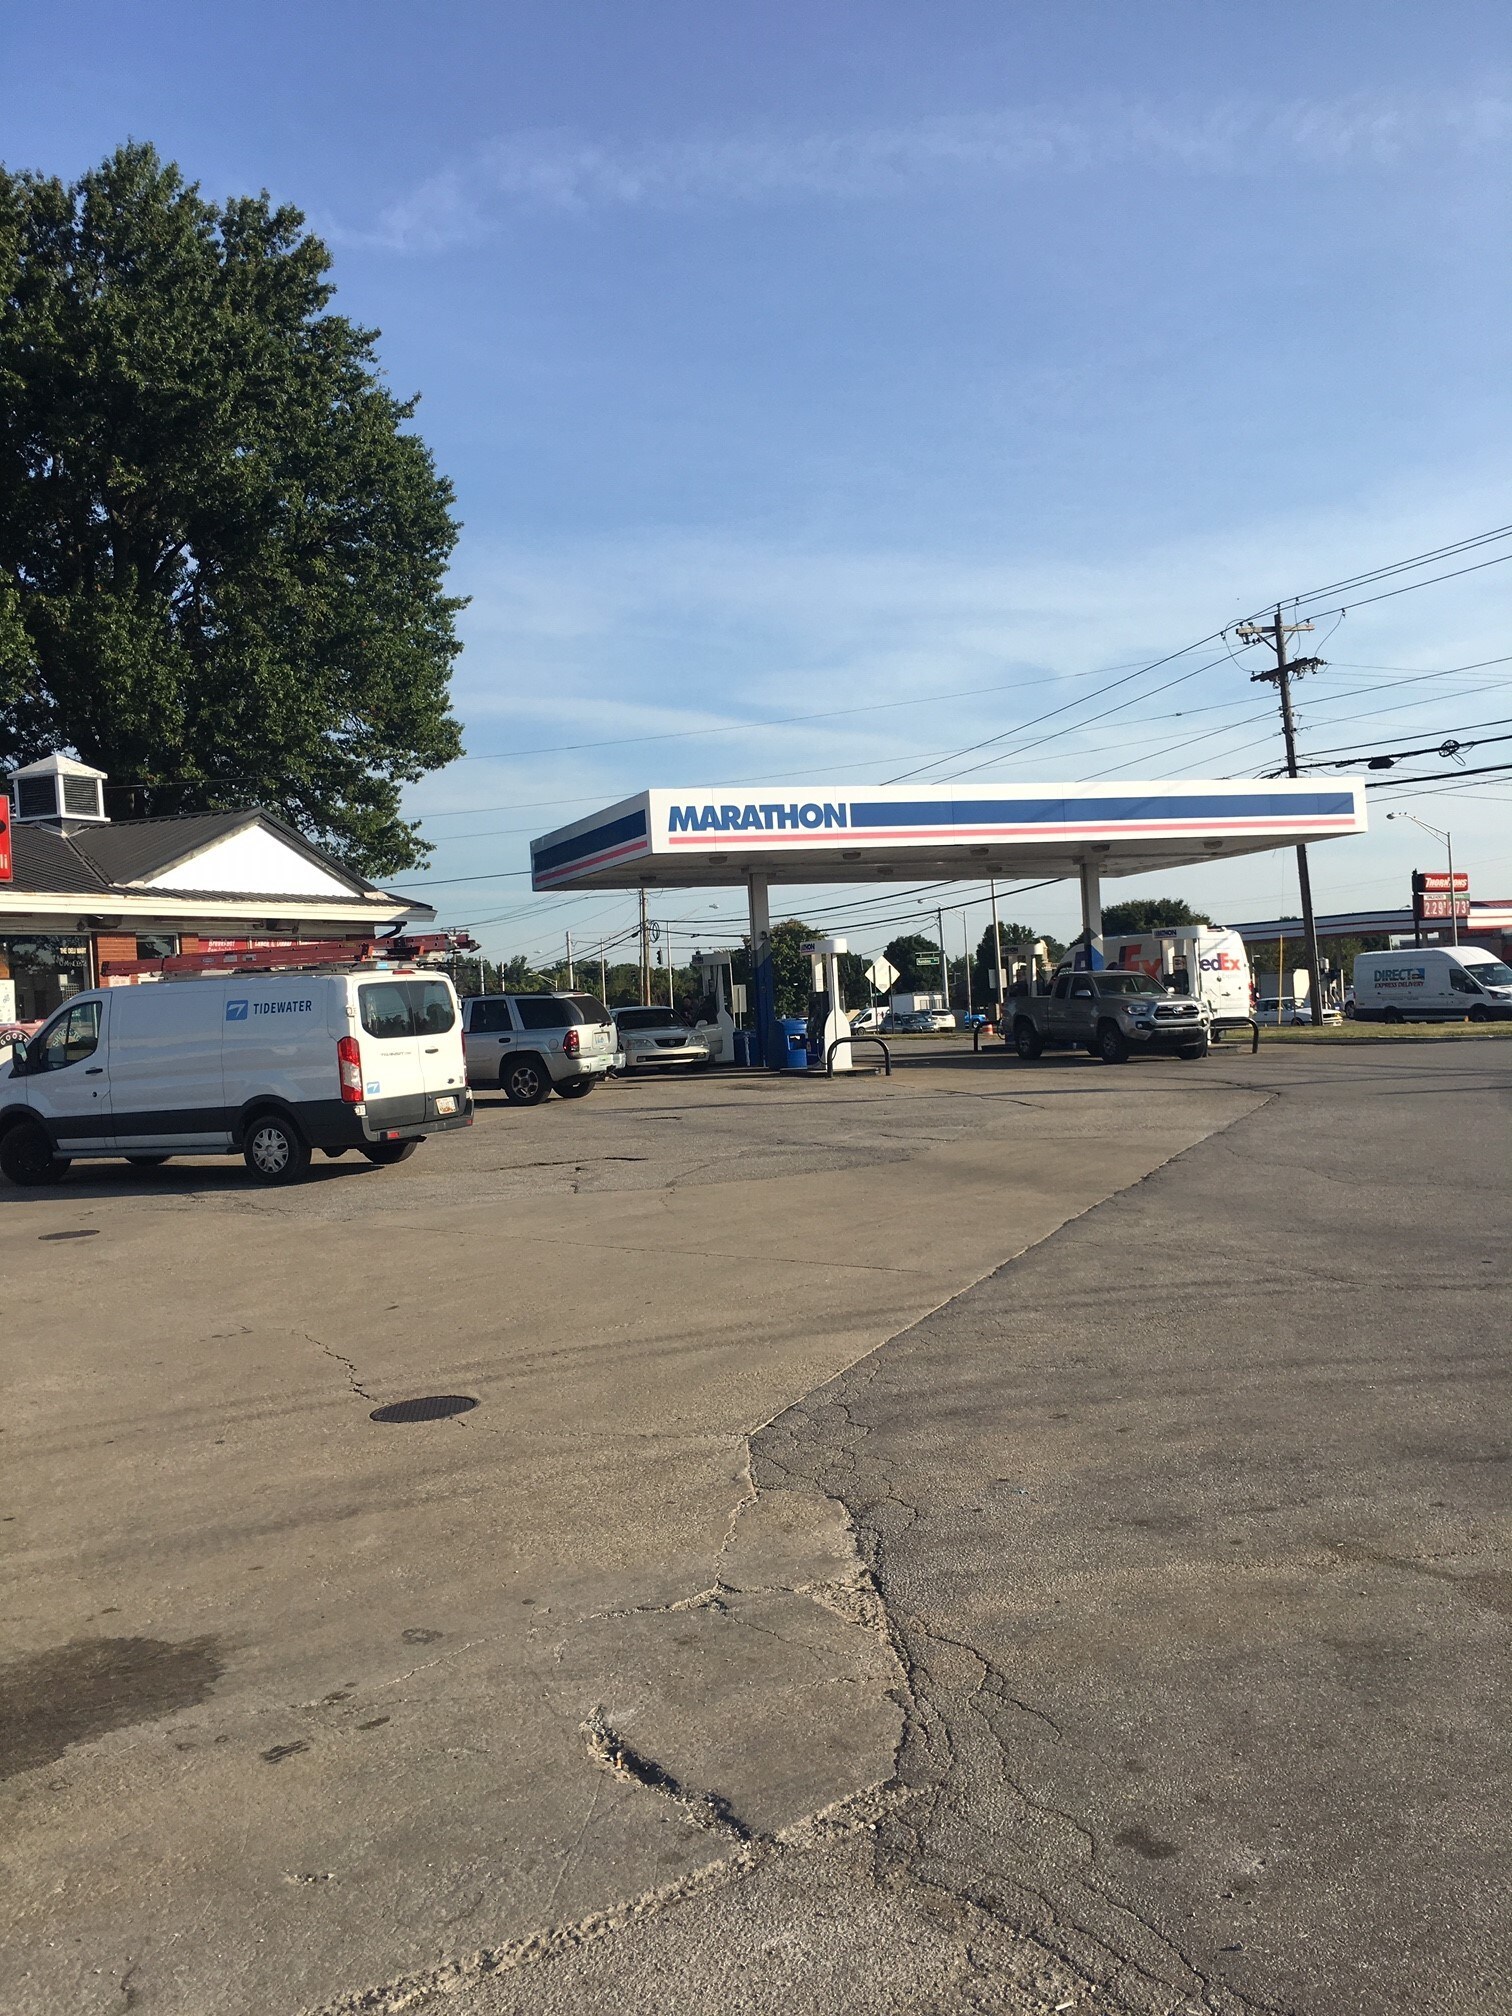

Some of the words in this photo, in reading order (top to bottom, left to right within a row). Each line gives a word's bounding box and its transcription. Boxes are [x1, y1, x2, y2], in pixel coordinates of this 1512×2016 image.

[668, 803, 847, 832] MARATHON
[1200, 953, 1241, 971] edEx
[1374, 969, 1413, 982] DIRECT
[253, 1000, 312, 1015] TIDEWATER
